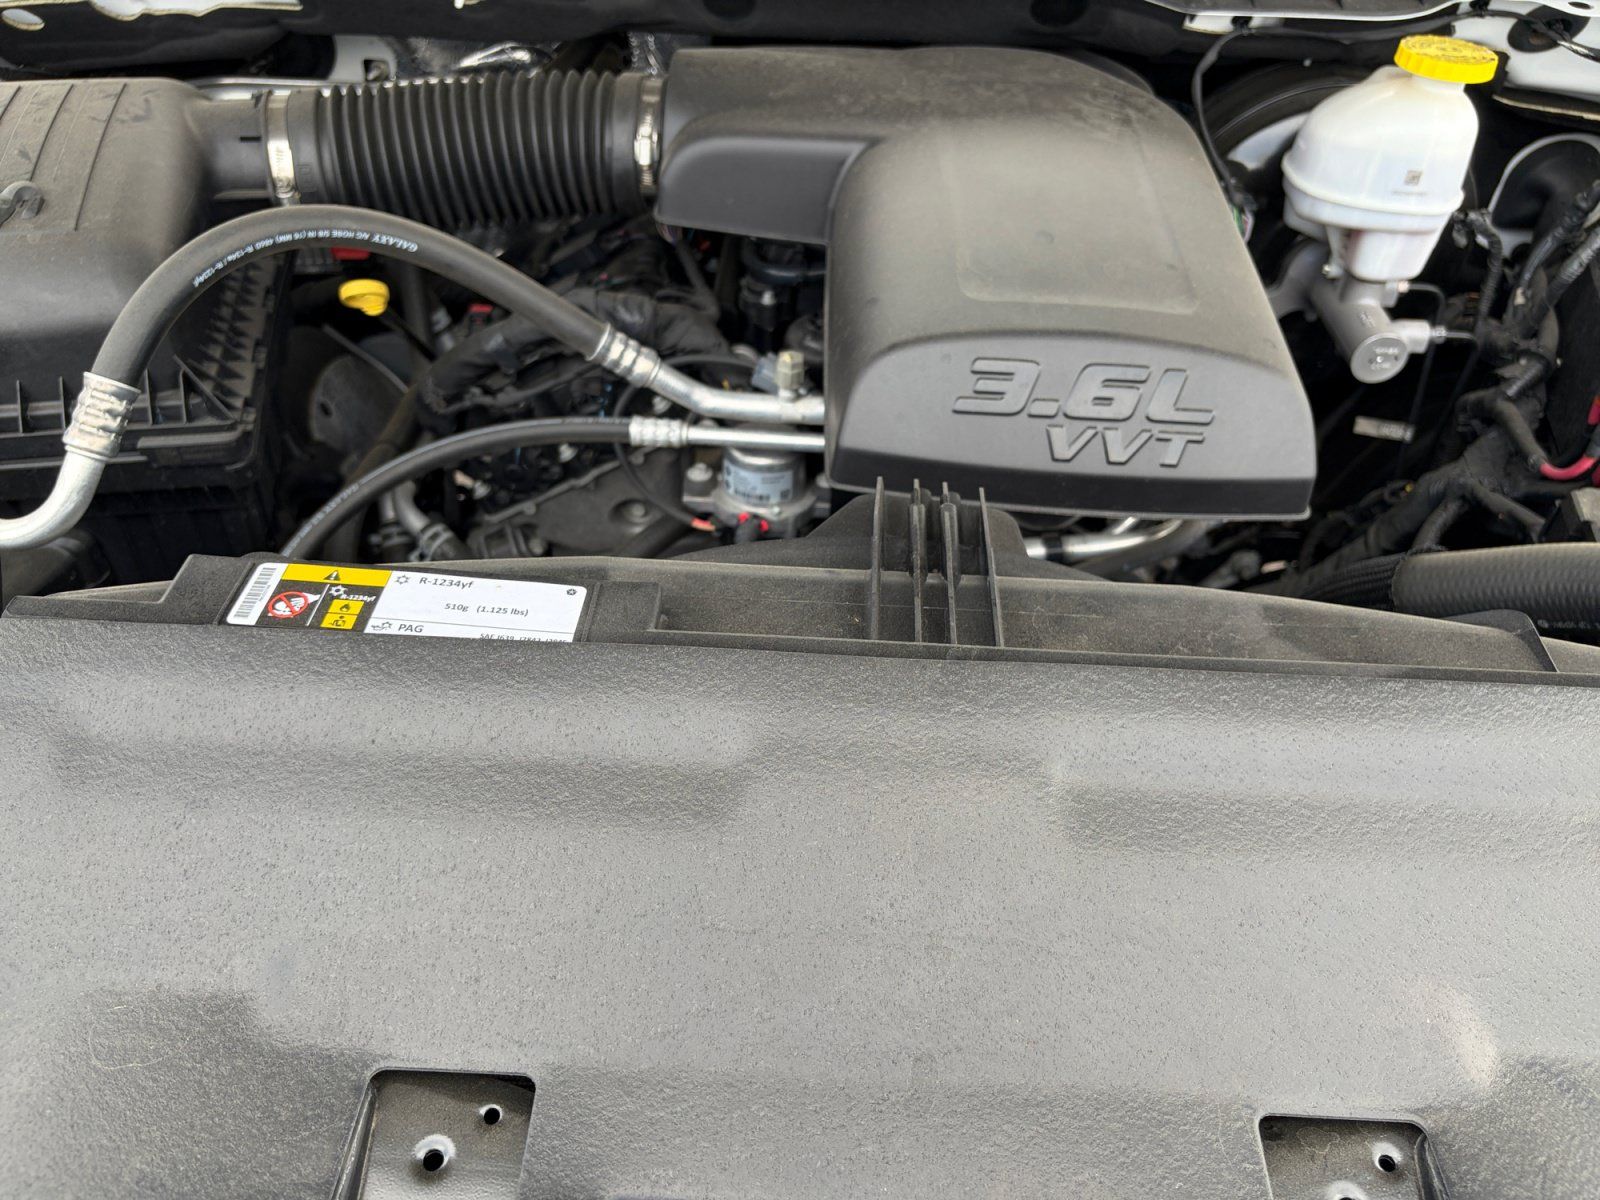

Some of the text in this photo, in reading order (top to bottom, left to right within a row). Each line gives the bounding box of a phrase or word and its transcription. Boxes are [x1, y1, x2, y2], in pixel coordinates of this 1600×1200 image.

[331, 229, 354, 239] HOSE
[371, 233, 418, 252] GALAXY
[952, 357, 1215, 425] 3.6L
[1046, 424, 1205, 468] VVT
[419, 576, 474, 589] R-1234yf
[444, 603, 529, 617] 510g (1.125 lbs)
[397, 623, 424, 633] PAG
